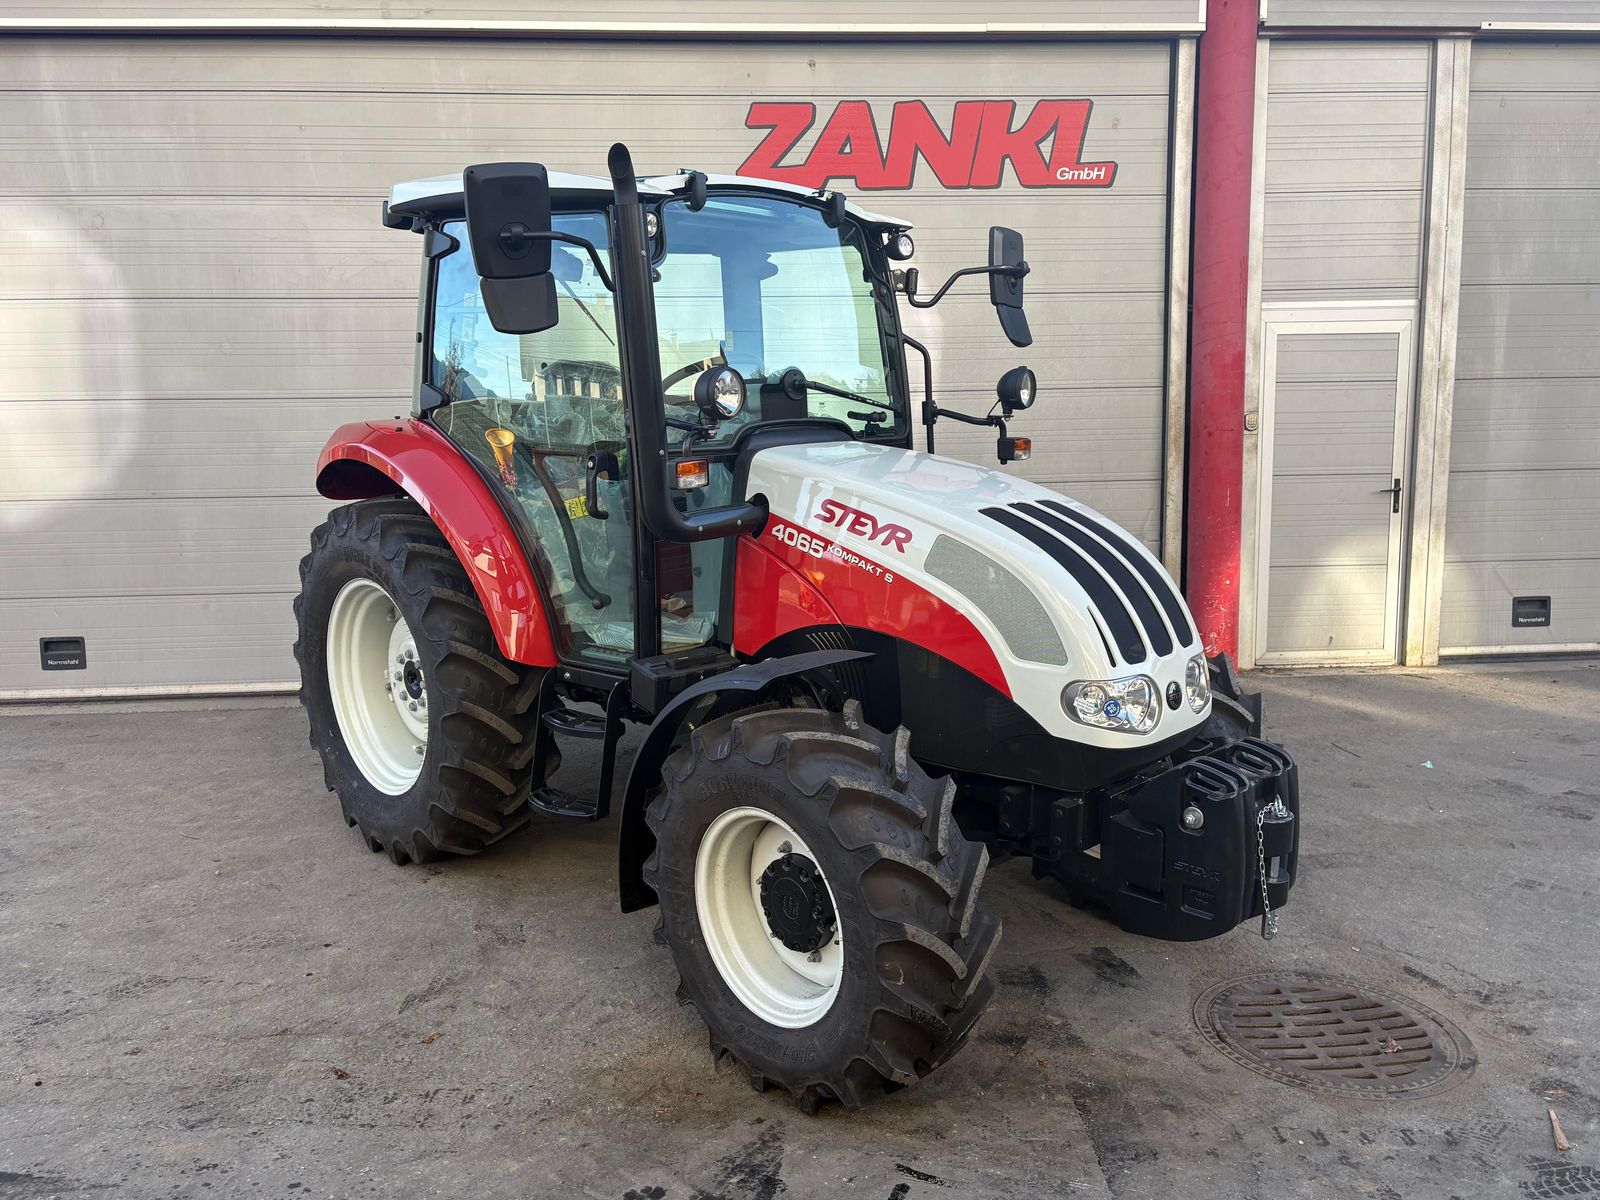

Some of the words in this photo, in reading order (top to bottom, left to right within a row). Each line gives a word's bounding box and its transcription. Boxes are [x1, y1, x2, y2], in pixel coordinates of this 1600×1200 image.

[736, 98, 1118, 189] ZANKL
[1056, 166, 1106, 181] GmbH
[771, 523, 825, 560] 4065
[826, 543, 883, 577] KOMPAKT
[883, 572, 894, 584] S
[814, 498, 913, 553] STEYR
